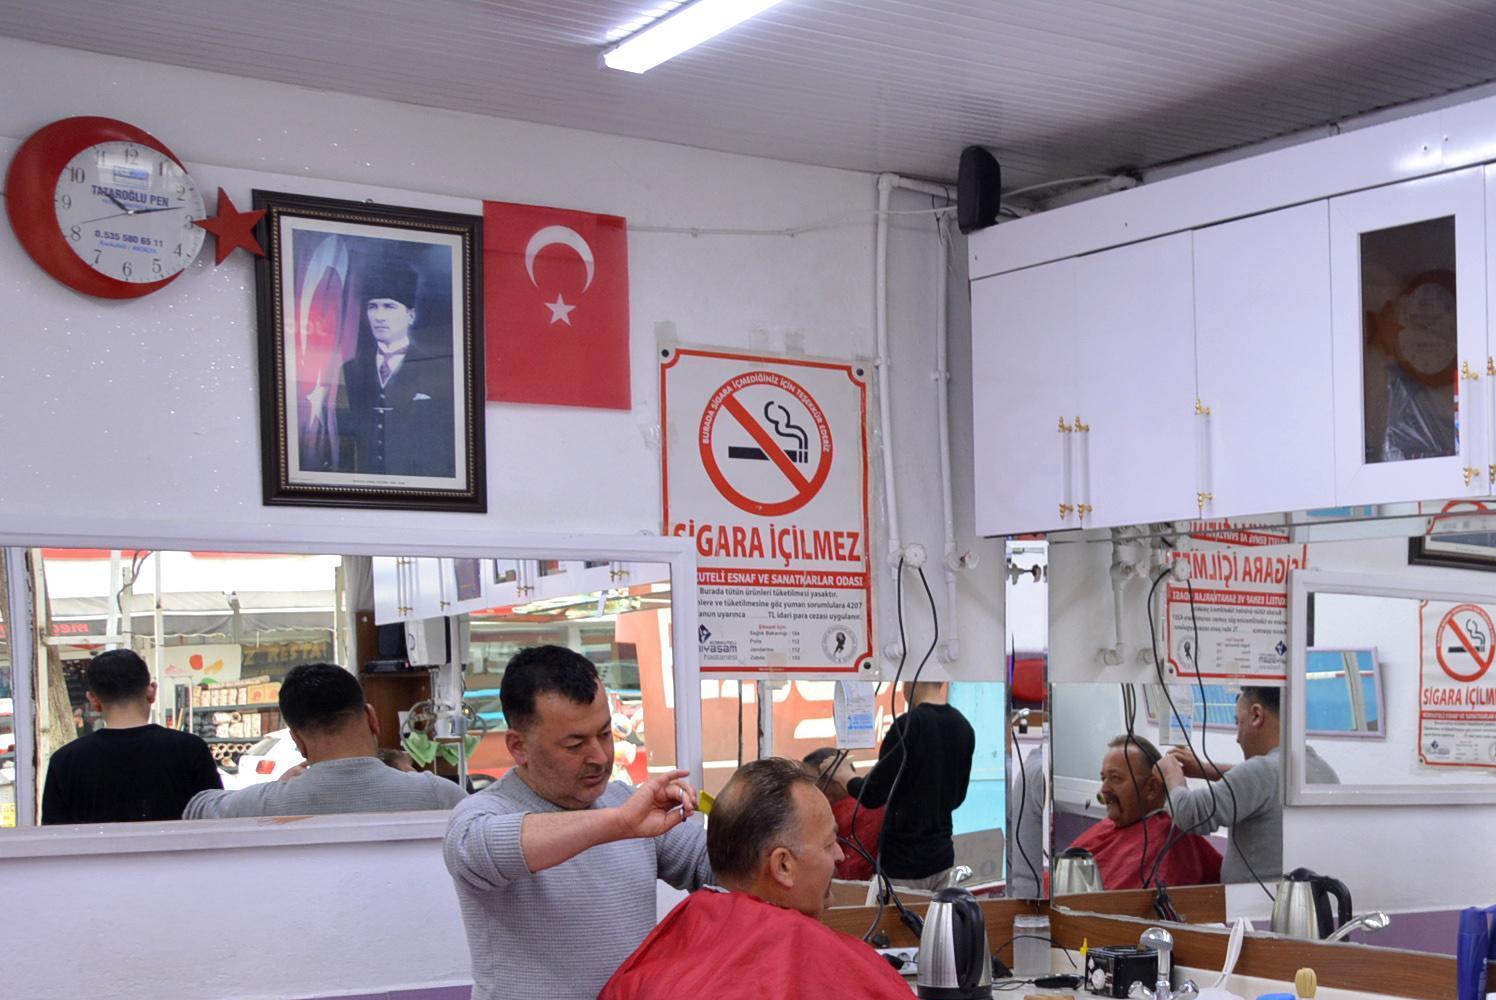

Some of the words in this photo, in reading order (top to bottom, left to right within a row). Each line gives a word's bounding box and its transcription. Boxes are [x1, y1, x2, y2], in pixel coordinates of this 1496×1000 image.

[95, 150, 106, 166] 11
[124, 148, 139, 165] 12
[70, 167, 85, 184] 10
[150, 194, 169, 207] PEN
[176, 186, 186, 201] 2
[61, 195, 72, 210] 9
[184, 215, 194, 230] 3
[70, 225, 81, 242] 8
[93, 249, 102, 264] 7
[173, 244, 183, 257] 4
[122, 262, 132, 277] 6
[152, 258, 162, 274] 5
[702, 413, 714, 445] BURADA
[711, 385, 733, 410] SİGARA
[732, 374, 779, 390] İÇMEDİĞİNİZ
[780, 379, 796, 392] İÇİN
[769, 523, 861, 567] İÇİLMEZ
[697, 570, 725, 583] UTELİ
[728, 573, 756, 584] ESNAF
[758, 574, 769, 584] VE
[836, 576, 863, 587] ODASI
[700, 587, 724, 595] Burada
[745, 588, 772, 596] ürünleri
[773, 589, 809, 597] tüketilmesi
[717, 611, 746, 619] uyarınca
[1423, 686, 1463, 706] SİGARA
